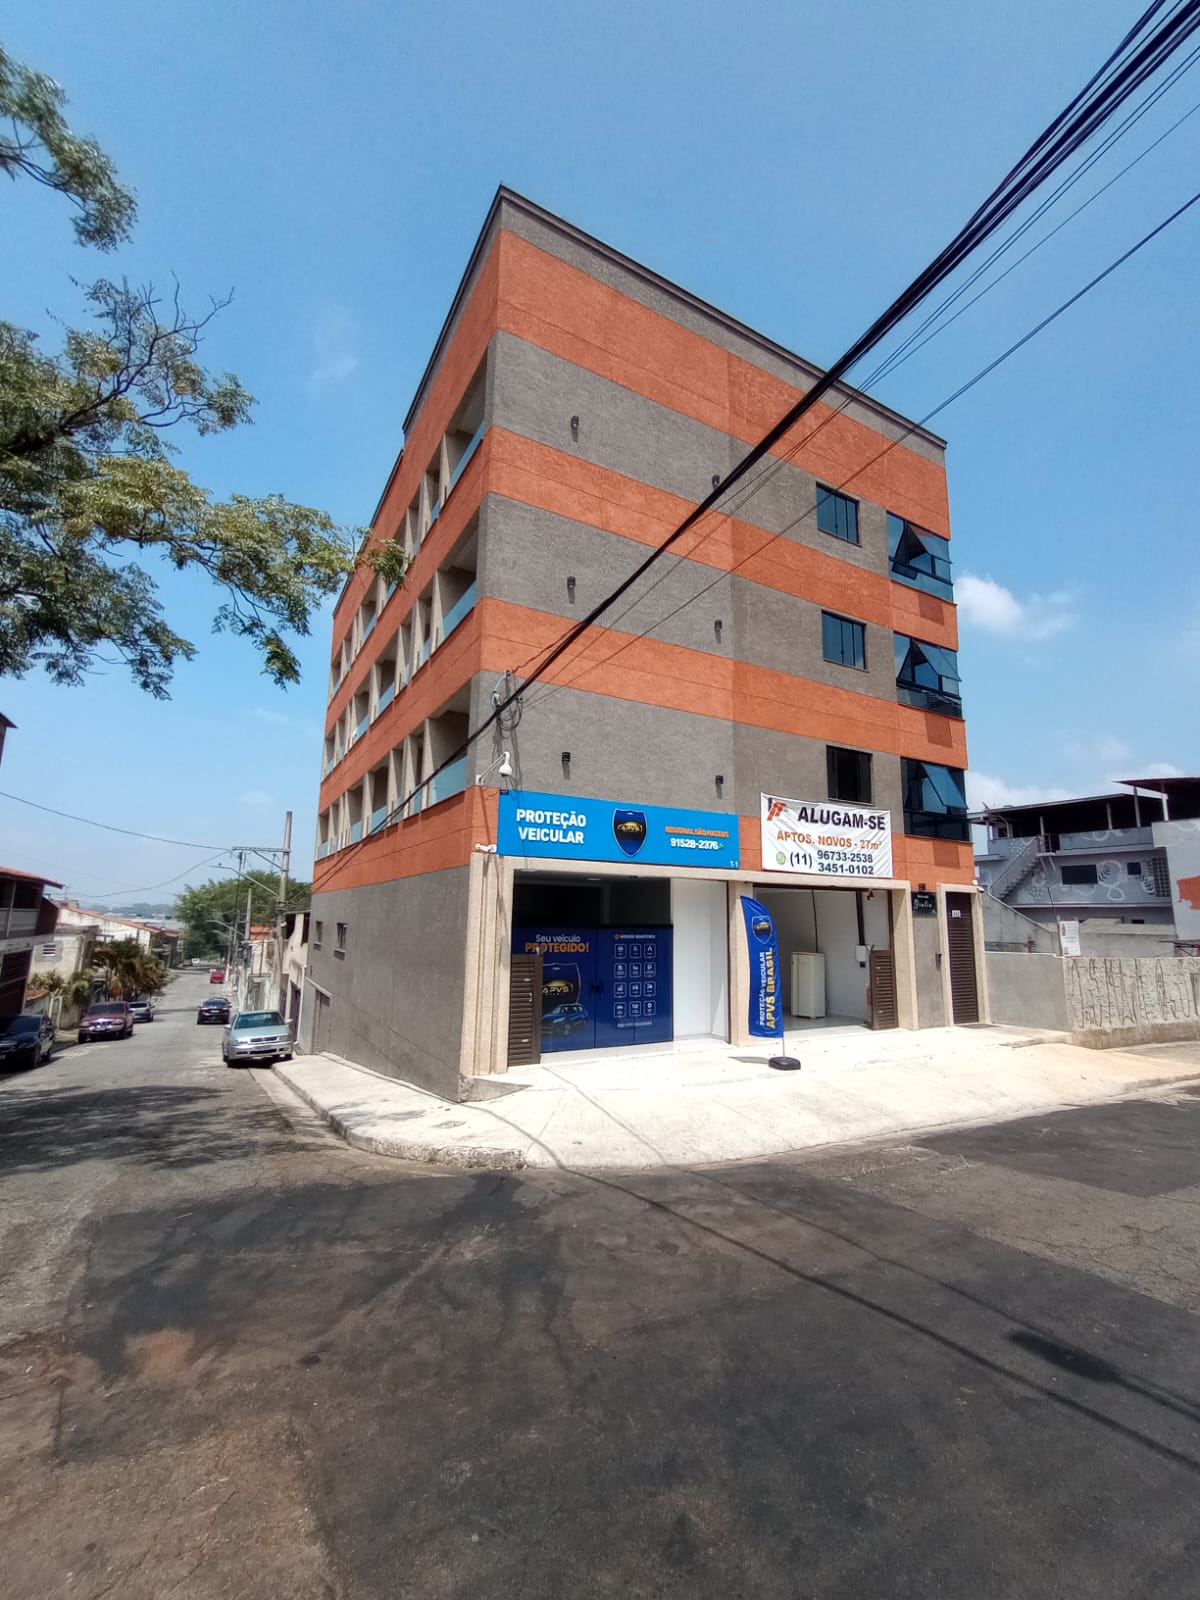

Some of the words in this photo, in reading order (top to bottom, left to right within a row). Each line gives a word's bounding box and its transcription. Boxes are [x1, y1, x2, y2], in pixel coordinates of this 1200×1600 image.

[516, 809, 587, 829] PROTEÇÃO
[798, 806, 886, 831] ALUGAM-SE
[518, 826, 584, 844] VEICULAR
[777, 830, 815, 845] APTOS.
[818, 836, 852, 848] NOVOS
[790, 852, 813, 869] (11)
[817, 849, 874, 863] 96733-2538
[818, 862, 875, 875] 3451-0102
[535, 934, 552, 943] Seu
[758, 951, 766, 988] VEICULAR
[765, 947, 776, 993] BRASIL
[758, 988, 766, 1026] PROTEÇÃO
[765, 996, 776, 1029] APVS
